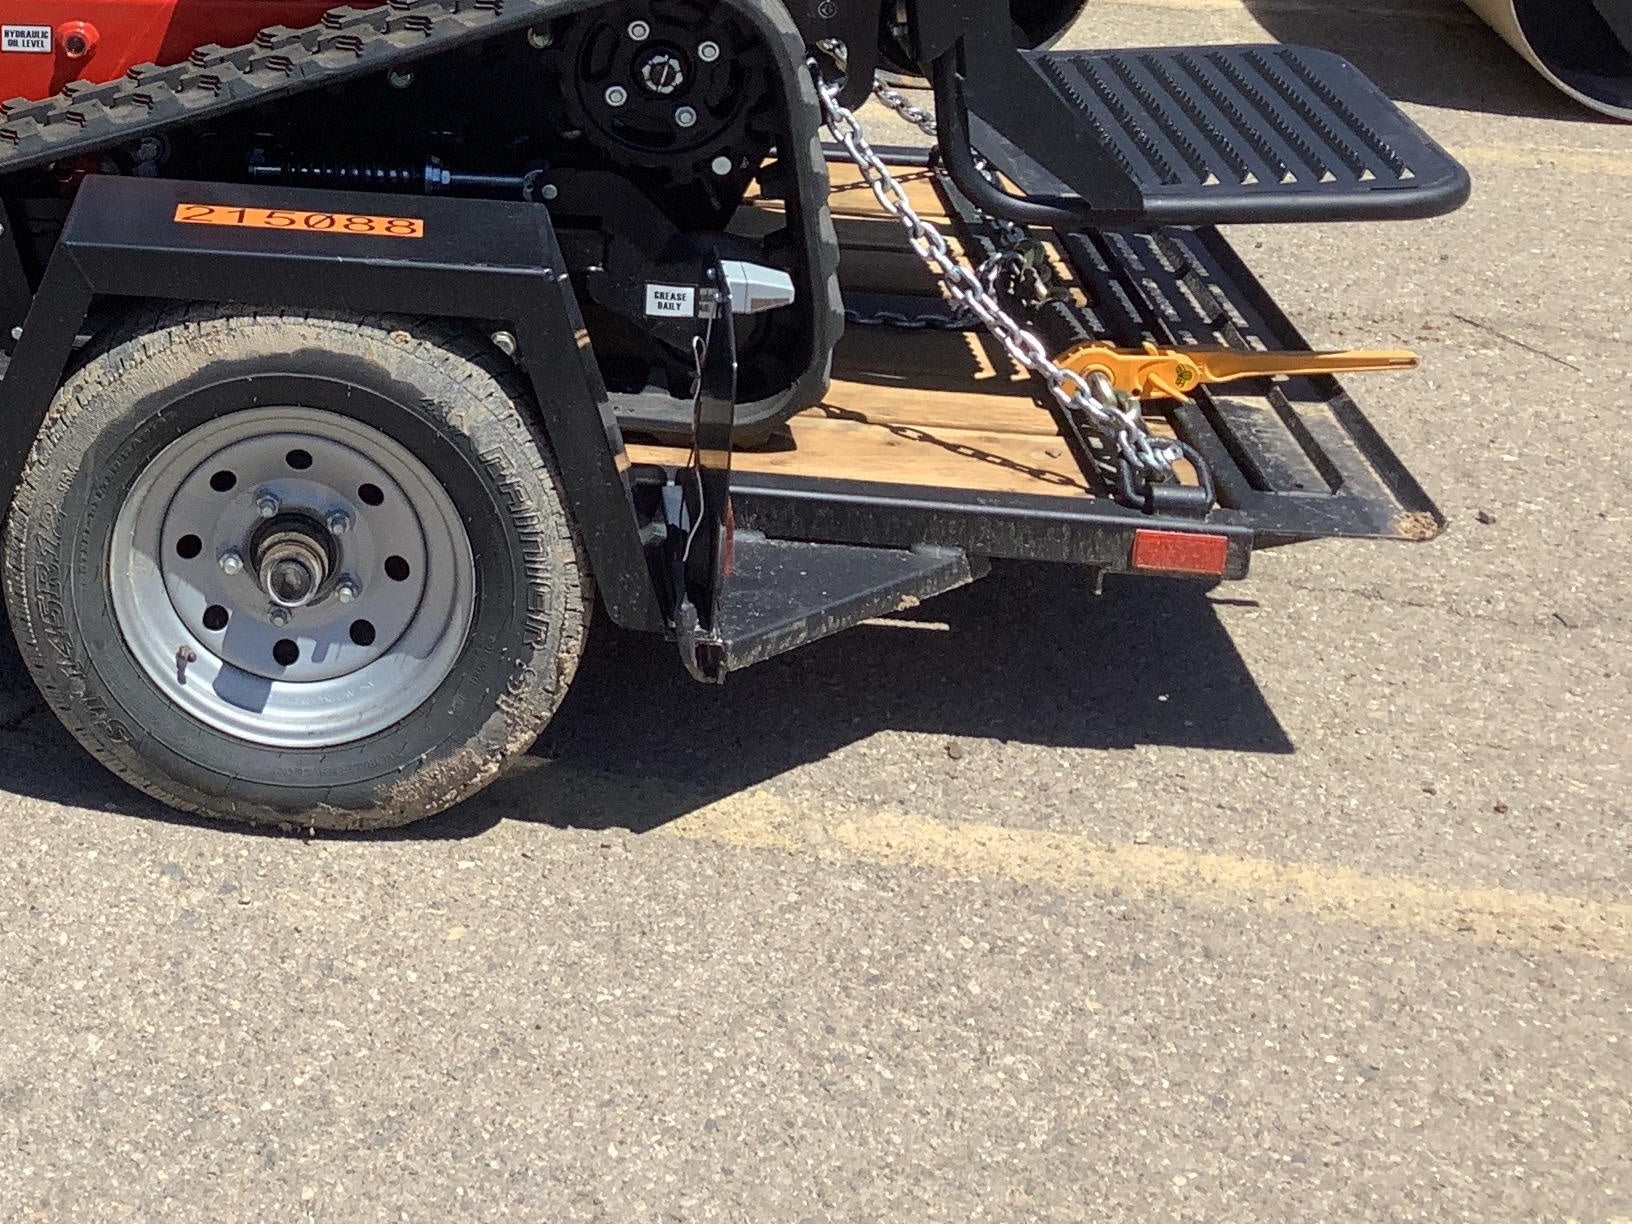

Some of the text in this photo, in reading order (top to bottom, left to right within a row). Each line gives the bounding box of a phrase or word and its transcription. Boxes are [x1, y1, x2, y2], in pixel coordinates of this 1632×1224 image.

[4, 29, 49, 39] HYDRAULIC
[7, 39, 45, 48] OIL LEVEL
[181, 205, 418, 235] 215088
[654, 290, 687, 302] GREASE
[657, 301, 682, 311] DAILY
